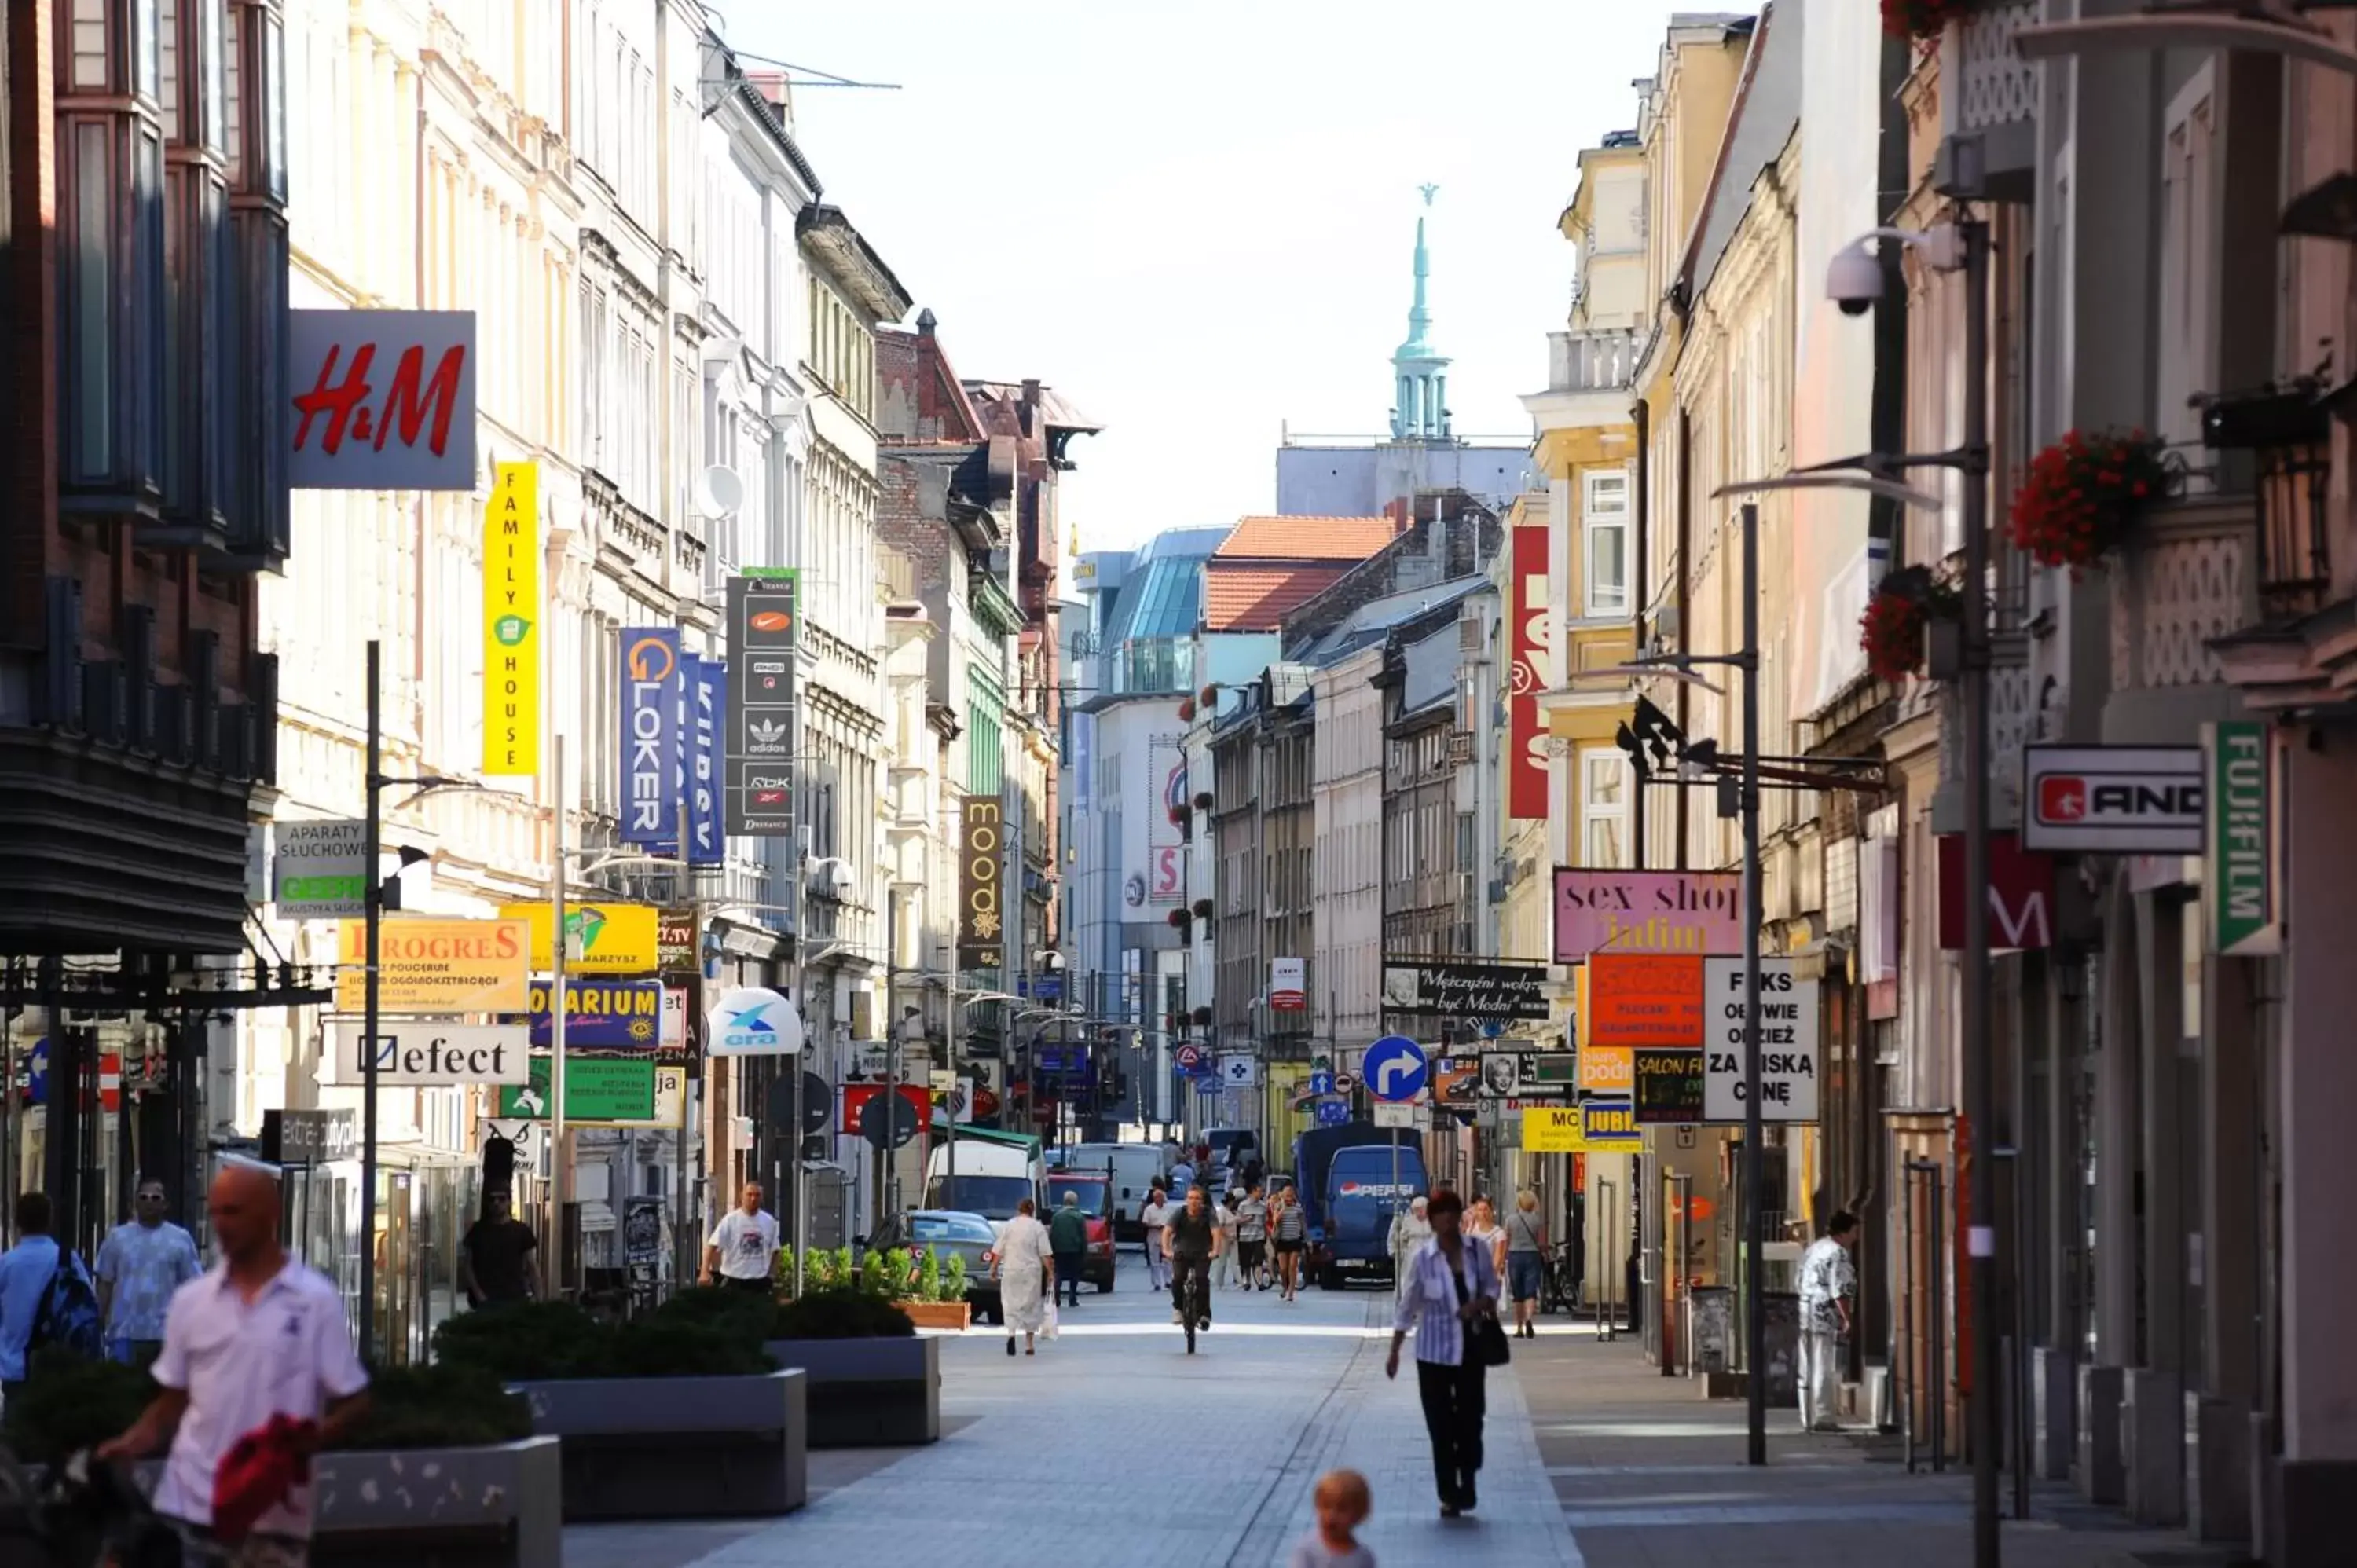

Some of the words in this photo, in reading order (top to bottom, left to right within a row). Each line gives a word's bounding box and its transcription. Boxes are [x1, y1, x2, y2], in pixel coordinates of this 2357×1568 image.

[291, 342, 466, 458] H&M
[504, 473, 519, 605] FAMILY
[505, 657, 517, 765] HOUSE
[749, 743, 786, 753] adidas
[289, 826, 360, 841] APARATY
[2225, 735, 2262, 918] FUJIFILM
[969, 803, 999, 912] mood
[1563, 885, 1634, 910] sex
[1729, 972, 1793, 991] FKS
[1724, 1003, 1798, 1020] OBWIE
[402, 1037, 508, 1075] efect
[1637, 1056, 1684, 1075] SALON
[1710, 1054, 1739, 1074] ZA
[1758, 1053, 1814, 1079] ISKĄ
[1733, 1081, 1791, 1106] CNĘ
[1360, 1184, 1414, 1196] PEPSI
